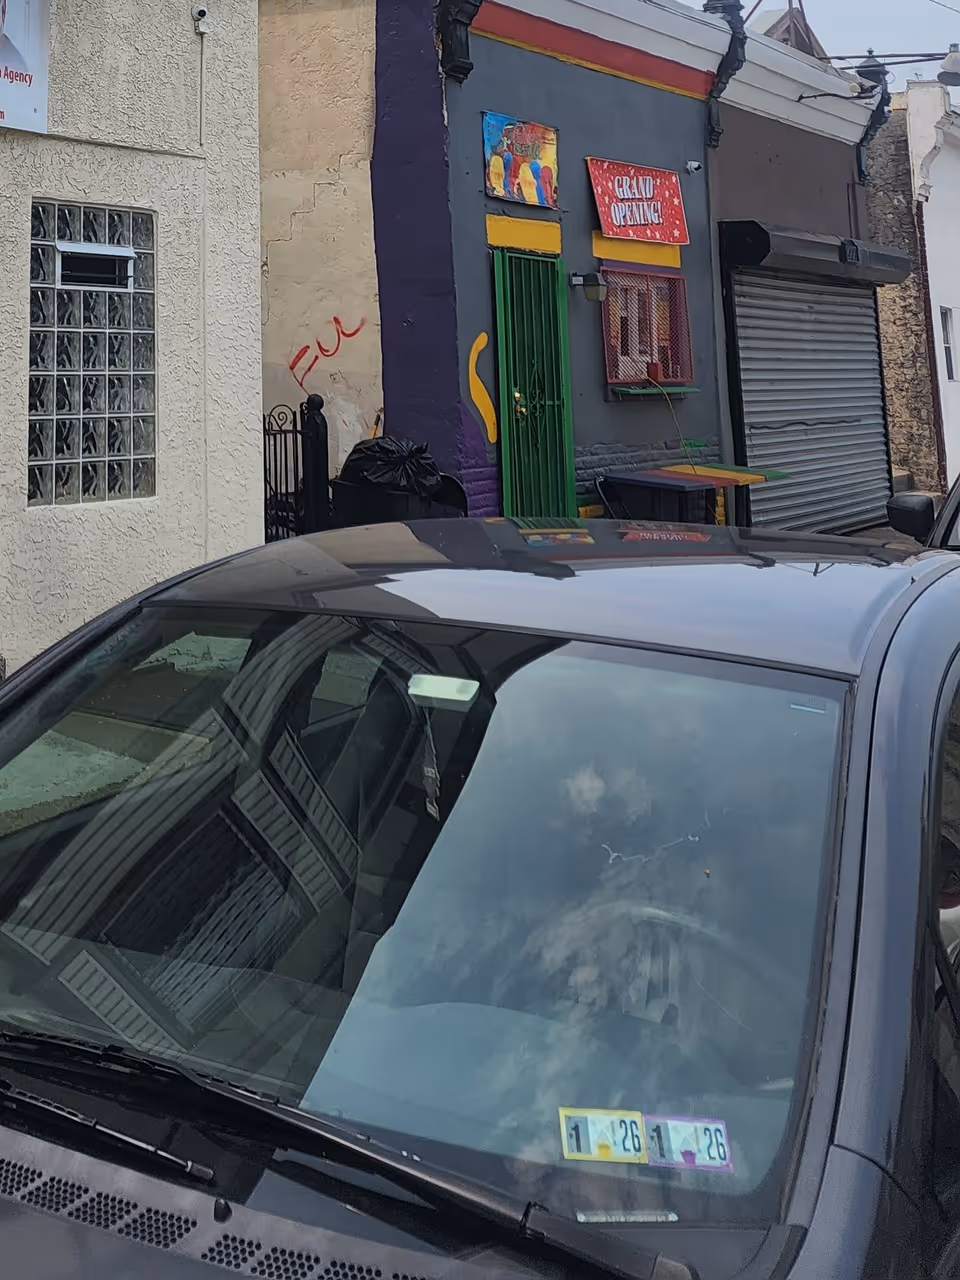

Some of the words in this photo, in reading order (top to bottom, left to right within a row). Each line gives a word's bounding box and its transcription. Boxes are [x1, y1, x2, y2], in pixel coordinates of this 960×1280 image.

[3, 65, 33, 87] Agency
[614, 175, 654, 199] GRAND
[610, 201, 664, 226] OPENING!
[619, 1120, 641, 1153] 26
[703, 1127, 727, 1161] 26
